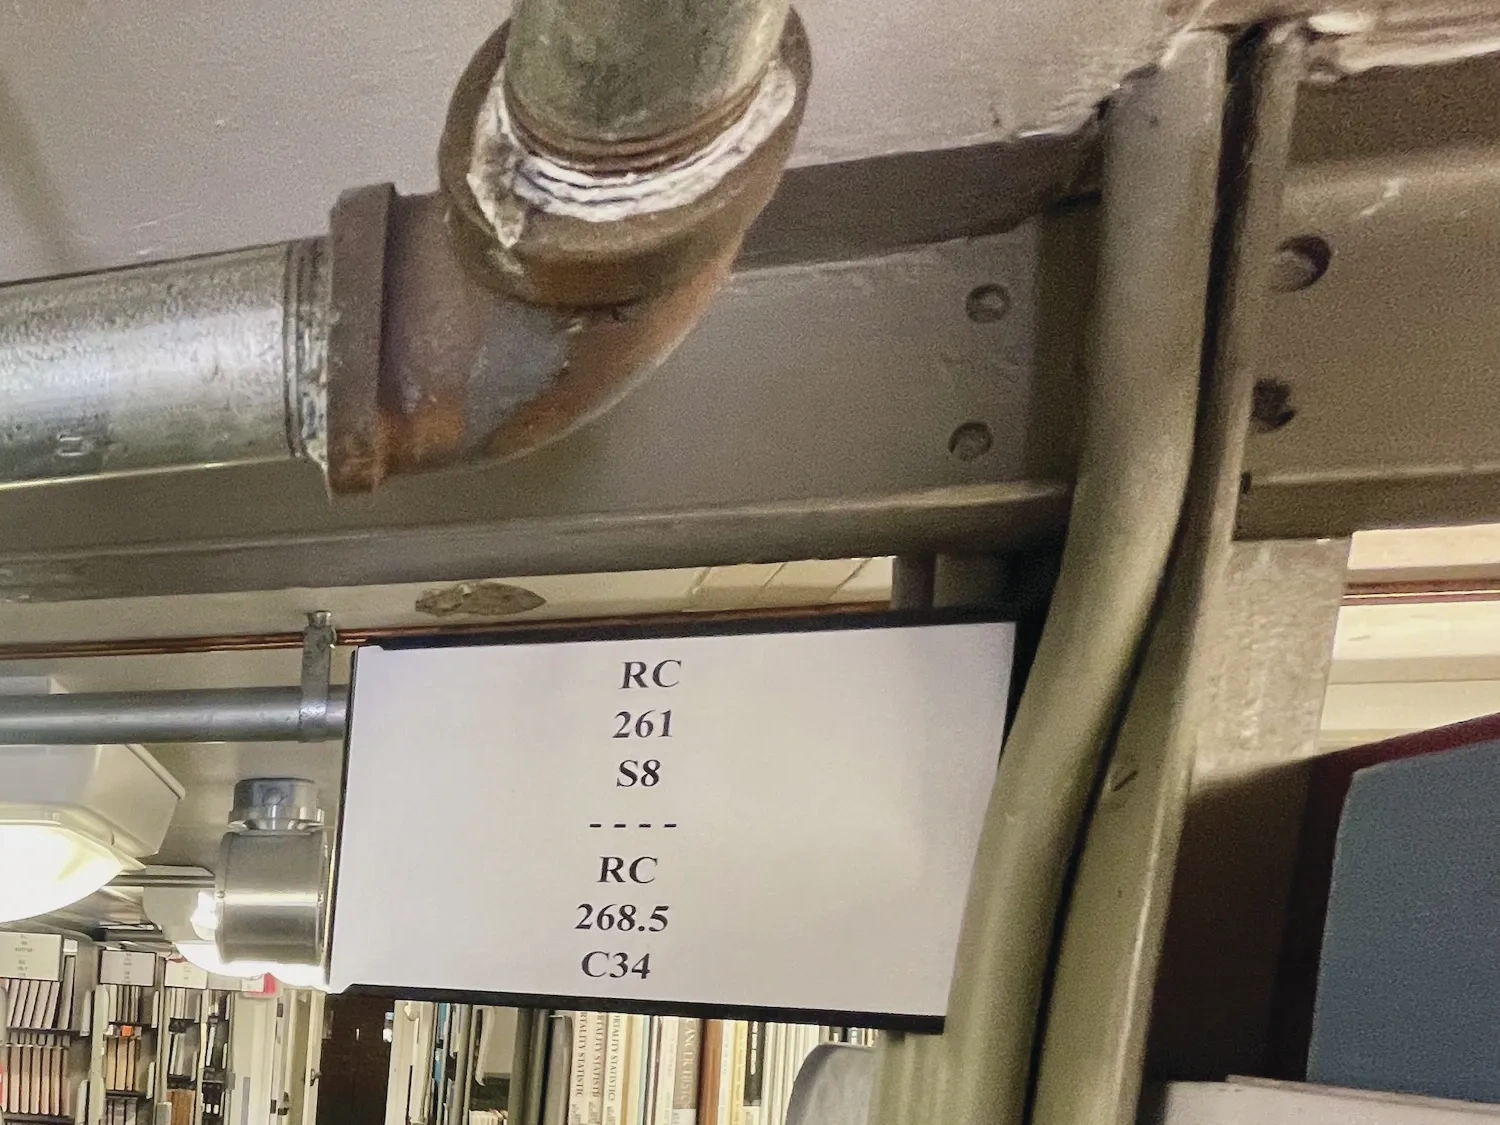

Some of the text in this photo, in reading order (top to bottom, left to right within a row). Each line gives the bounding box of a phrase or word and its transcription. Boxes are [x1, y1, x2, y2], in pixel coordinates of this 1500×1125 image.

[620, 660, 682, 690] RC
[612, 709, 673, 739] 261
[616, 759, 661, 788] S8
[596, 856, 658, 884] RC
[574, 903, 670, 932] 268.5
[581, 950, 651, 980] C34
[594, 1012, 604, 1052] RTALITY
[576, 1011, 588, 1096] RTALITY STATISTIC
